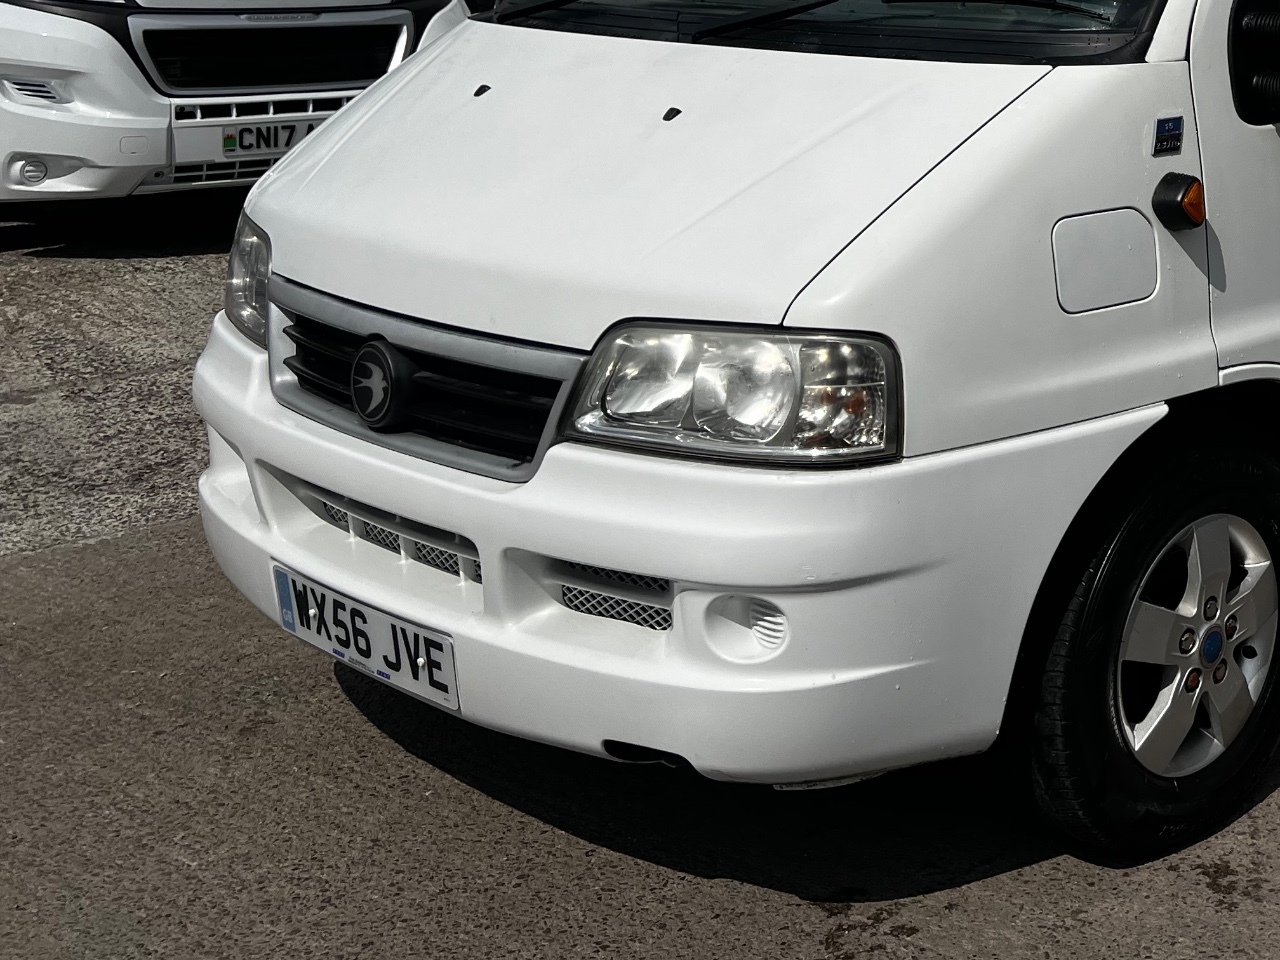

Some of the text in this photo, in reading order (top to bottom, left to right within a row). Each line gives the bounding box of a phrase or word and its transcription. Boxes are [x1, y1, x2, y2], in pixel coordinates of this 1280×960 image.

[238, 124, 297, 150] CN17
[282, 609, 293, 623] GB
[291, 578, 449, 695] WX56 JVE
